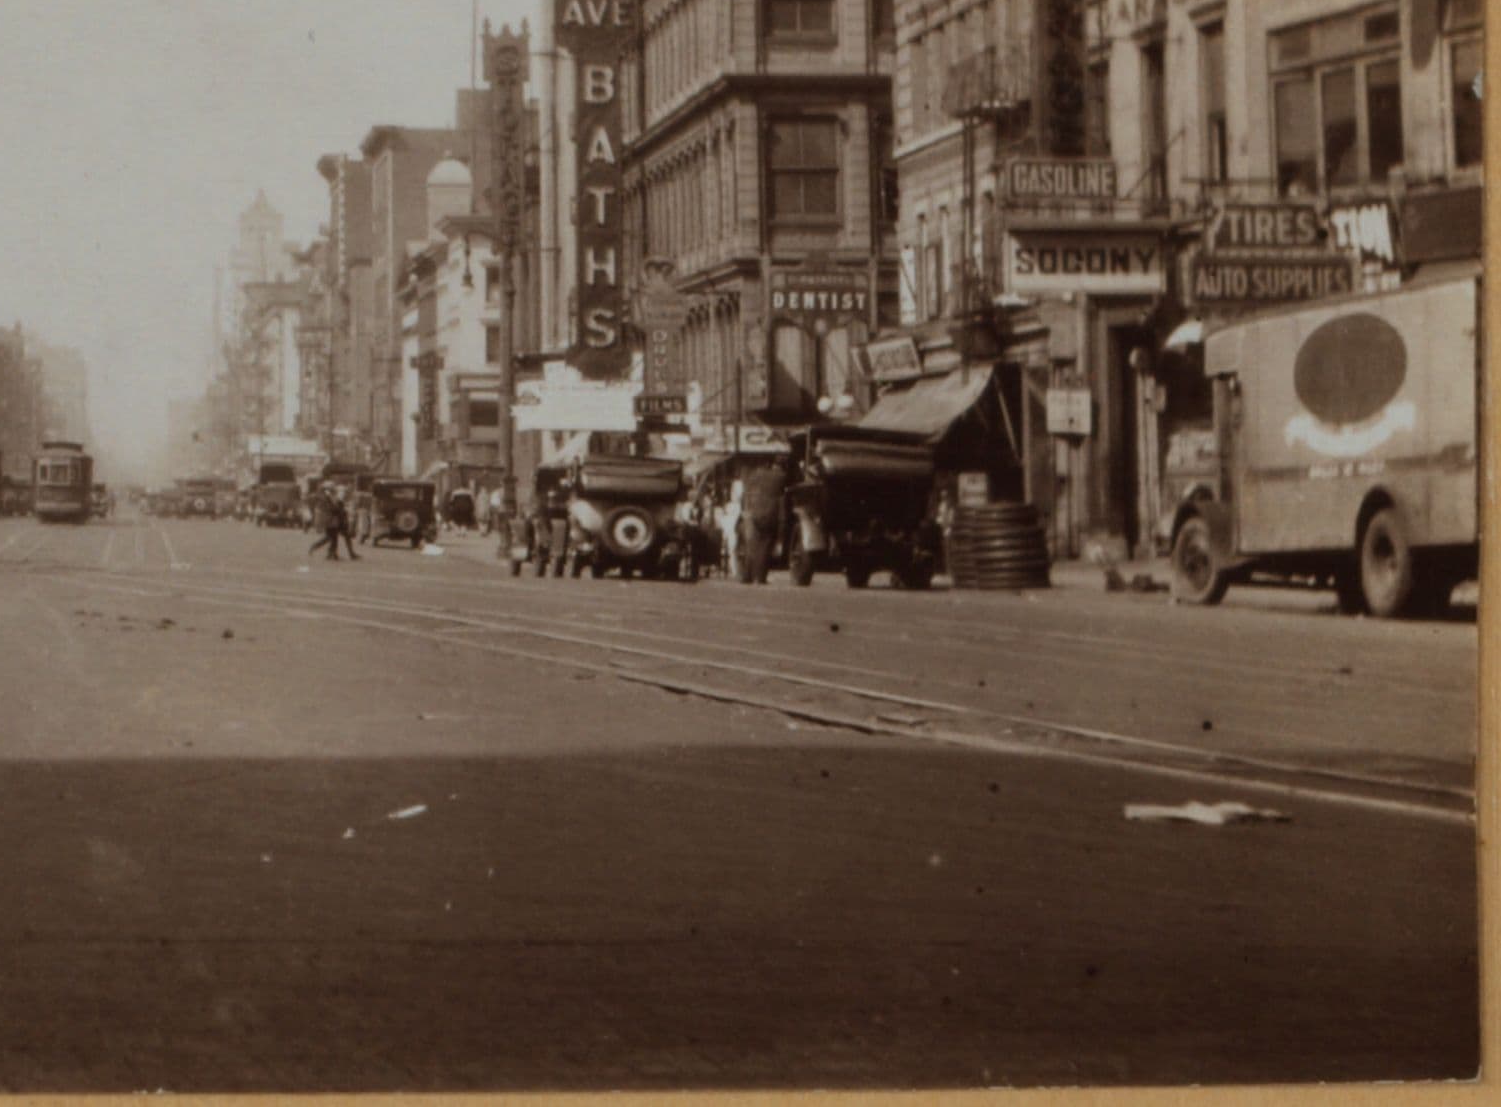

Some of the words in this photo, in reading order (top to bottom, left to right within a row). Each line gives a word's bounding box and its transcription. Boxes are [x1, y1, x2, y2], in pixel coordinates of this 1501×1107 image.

[561, 0, 630, 29] AVE
[1013, 164, 1114, 197] GASOLINE
[581, 66, 617, 348] BATHS
[1227, 209, 1317, 245] TIRES
[1015, 248, 1154, 274] SOCONY
[1196, 266, 1248, 298] AUTO
[1251, 264, 1347, 296] SUPPLIES
[773, 291, 866, 310] DENTIST
